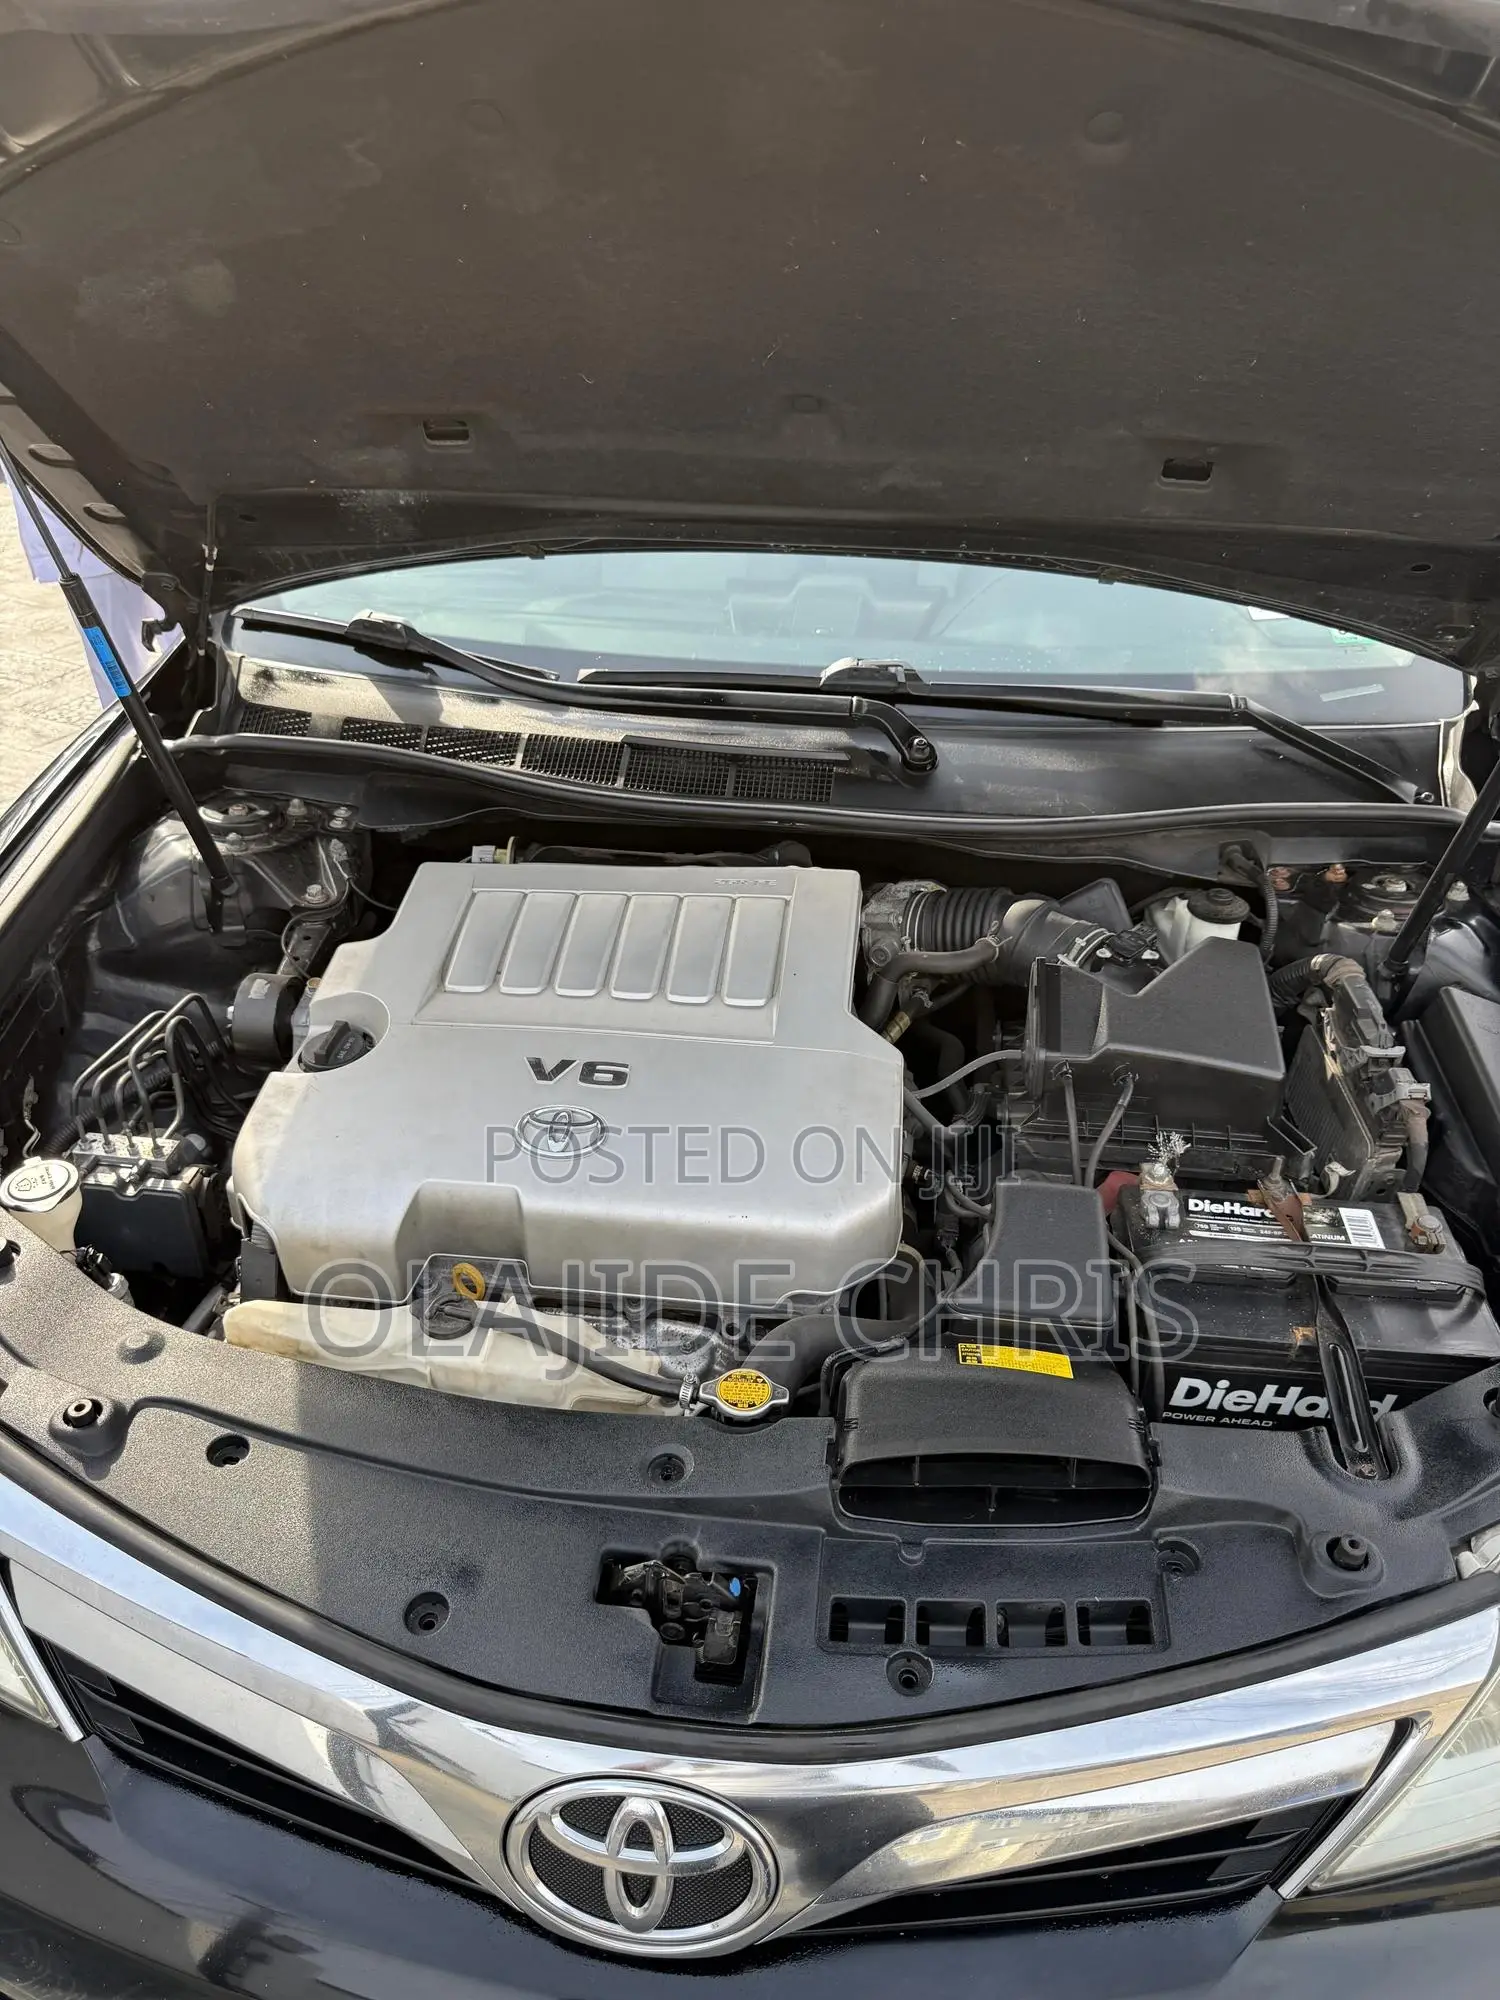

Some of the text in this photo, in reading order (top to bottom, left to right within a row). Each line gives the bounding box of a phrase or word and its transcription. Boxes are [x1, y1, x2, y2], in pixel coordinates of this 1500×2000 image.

[525, 1056, 631, 1089] V6
[1310, 1233, 1346, 1241] ATINUM
[1168, 1376, 1399, 1423] DieHad
[1161, 1410, 1273, 1427] POWER AHEAD
